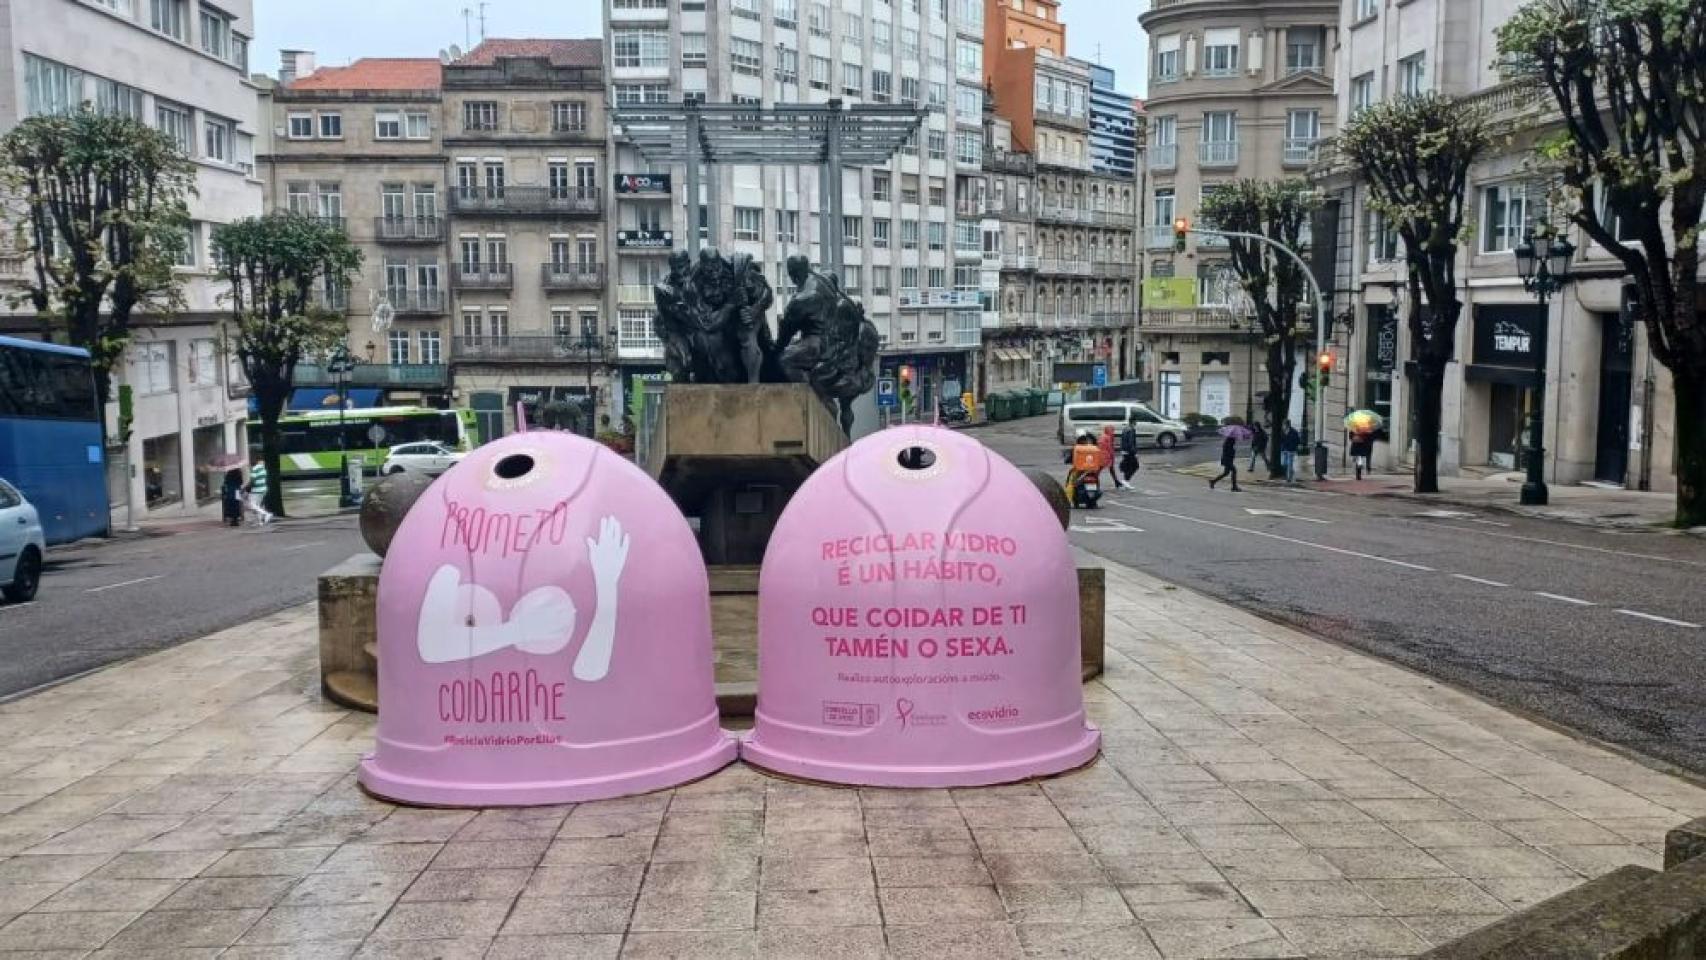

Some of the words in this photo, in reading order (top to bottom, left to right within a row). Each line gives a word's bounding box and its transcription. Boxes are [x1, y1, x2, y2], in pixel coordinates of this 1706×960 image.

[1493, 334, 1531, 353] TEMPUR
[440, 501, 569, 558] PROMETO
[822, 532, 936, 561] RECICLAR
[945, 532, 1018, 557] VIDRO
[838, 561, 851, 586] É
[858, 562, 896, 584] UN
[903, 555, 1004, 587] HÁBITO,
[811, 606, 859, 627] QUE
[865, 607, 964, 628] COIDAR
[972, 606, 1004, 626] DE
[1008, 604, 1027, 625] TI
[824, 634, 909, 659] TAMÉN
[918, 637, 939, 659] O
[945, 636, 1015, 657] SEXA.
[438, 668, 567, 724] COIDARME
[968, 705, 1019, 721] ecovidrio
